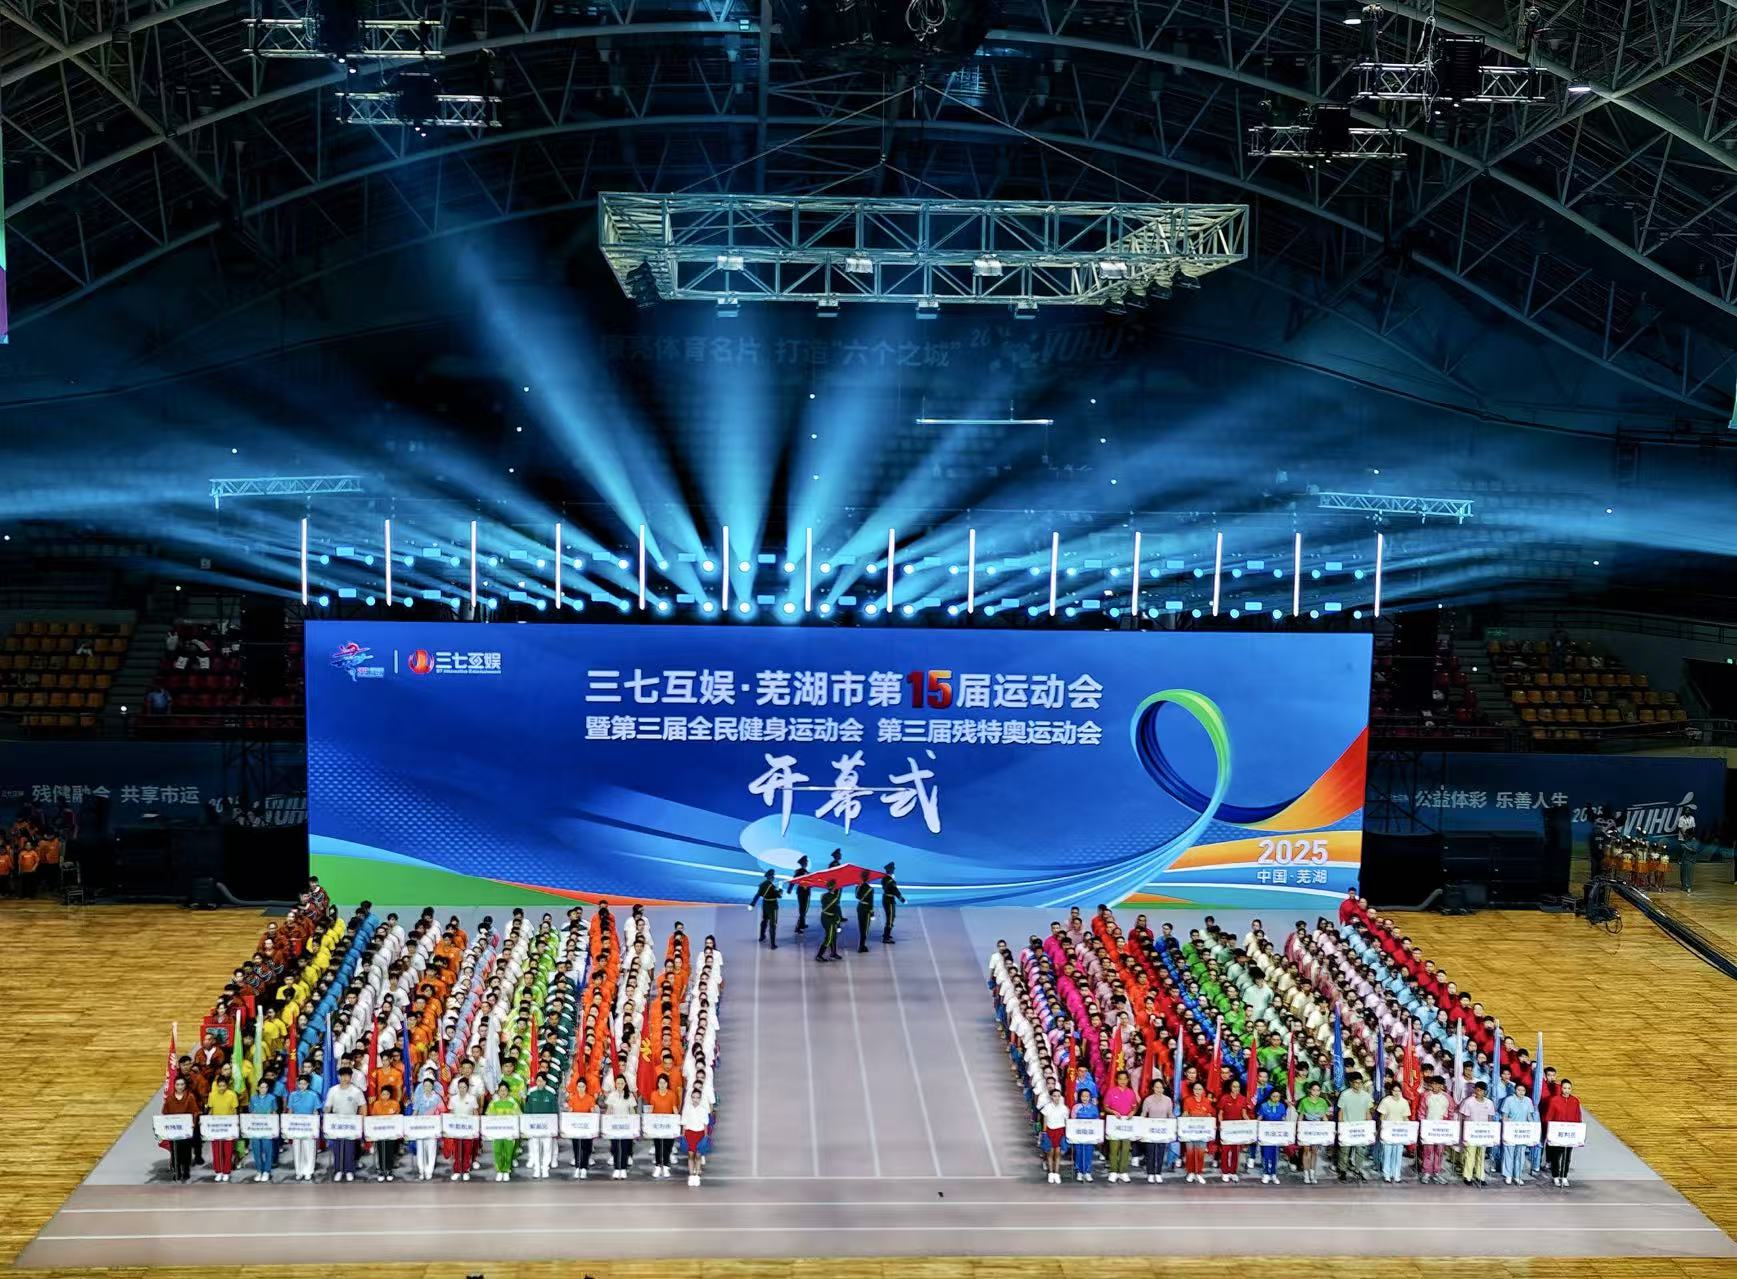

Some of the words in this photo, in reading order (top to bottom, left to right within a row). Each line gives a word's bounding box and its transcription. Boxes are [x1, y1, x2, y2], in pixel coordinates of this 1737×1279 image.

[435, 652, 502, 669] 三七互娱
[585, 668, 1104, 709] 三七互娱·芜湖市第15届运动会
[585, 715, 864, 743] 暨第三届全民健身运动会
[877, 717, 1103, 745] 第三届残特奥运动会
[120, 784, 200, 805] 共享市运
[748, 750, 941, 837] 开幕式
[1414, 789, 1488, 809] 公益体彩
[1258, 839, 1328, 865] 2025
[1257, 869, 1328, 884] 中国·芜湖
